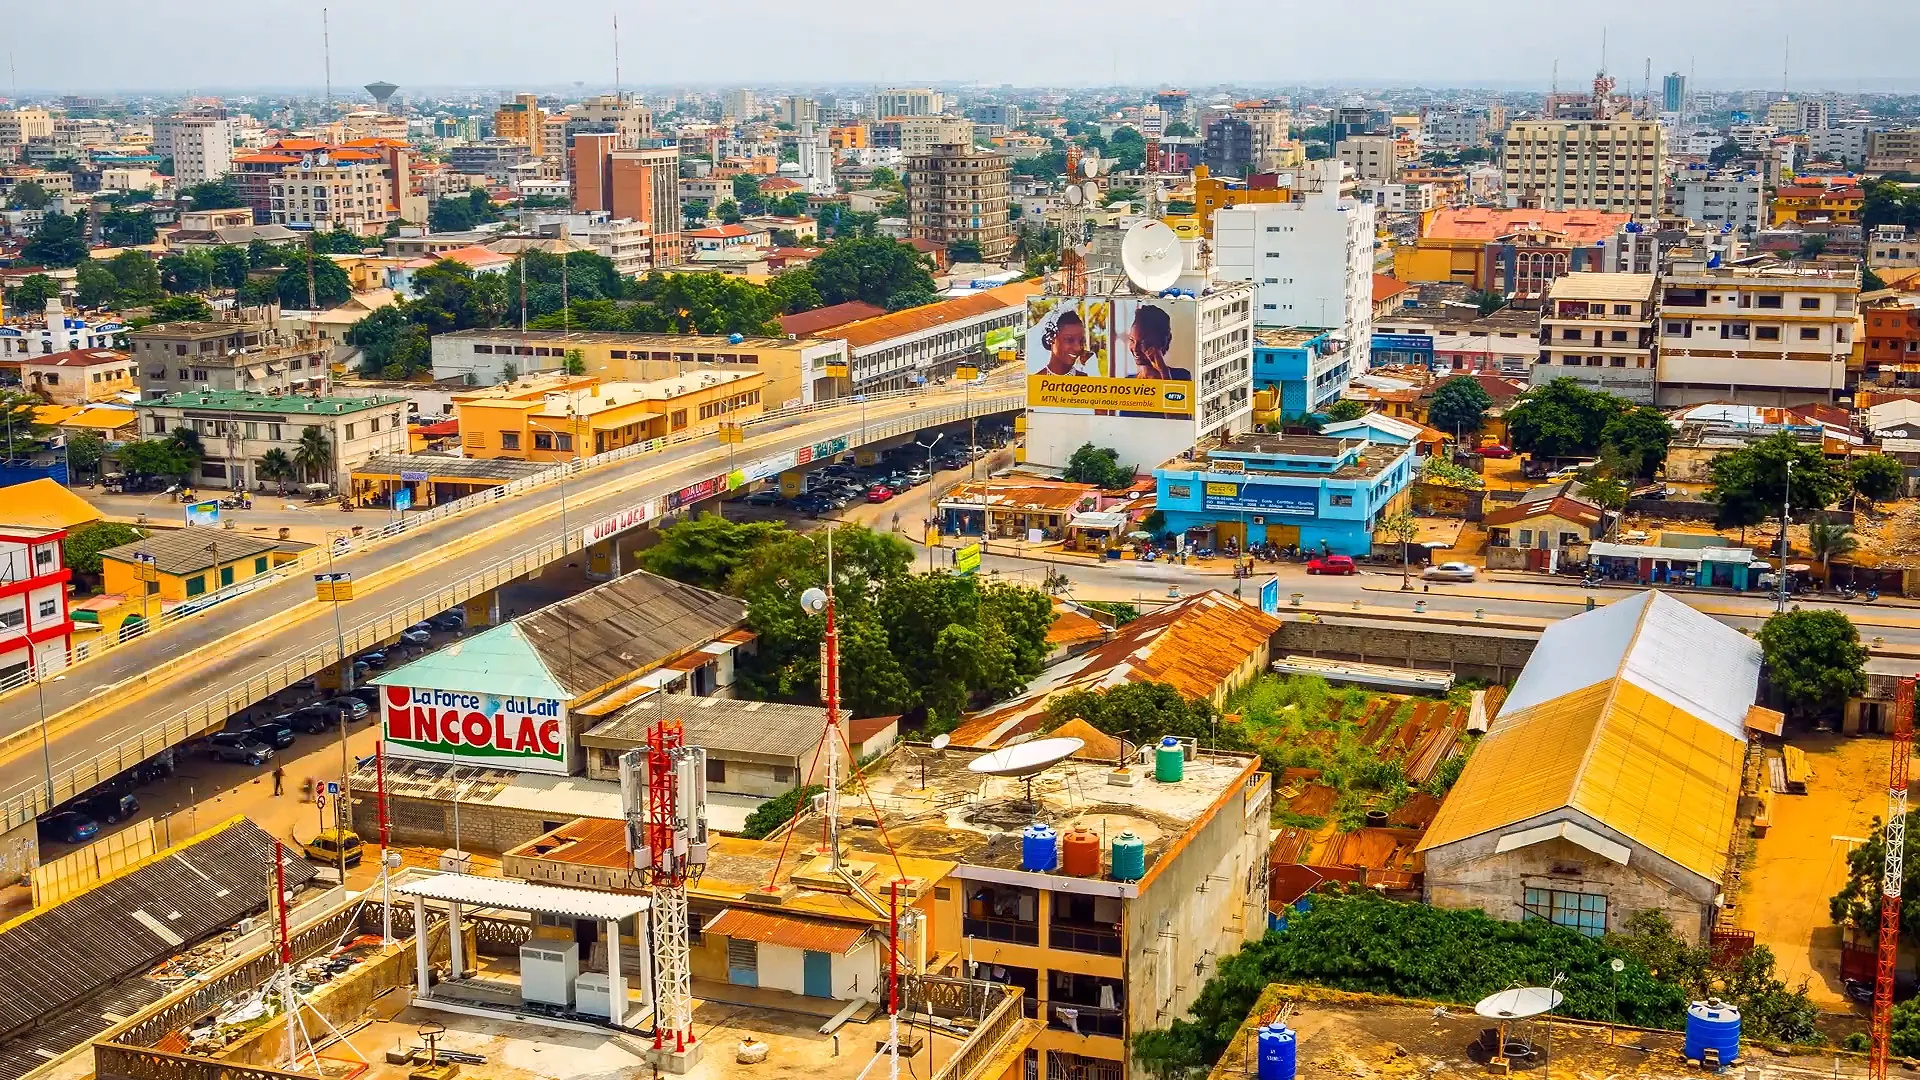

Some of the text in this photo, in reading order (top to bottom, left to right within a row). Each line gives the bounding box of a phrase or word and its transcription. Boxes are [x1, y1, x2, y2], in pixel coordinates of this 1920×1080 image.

[1041, 380, 1156, 396] Partageons nos vies
[1060, 396, 1066, 404] le
[1090, 398, 1100, 406] qui
[412, 687, 560, 717] La Force du Lait
